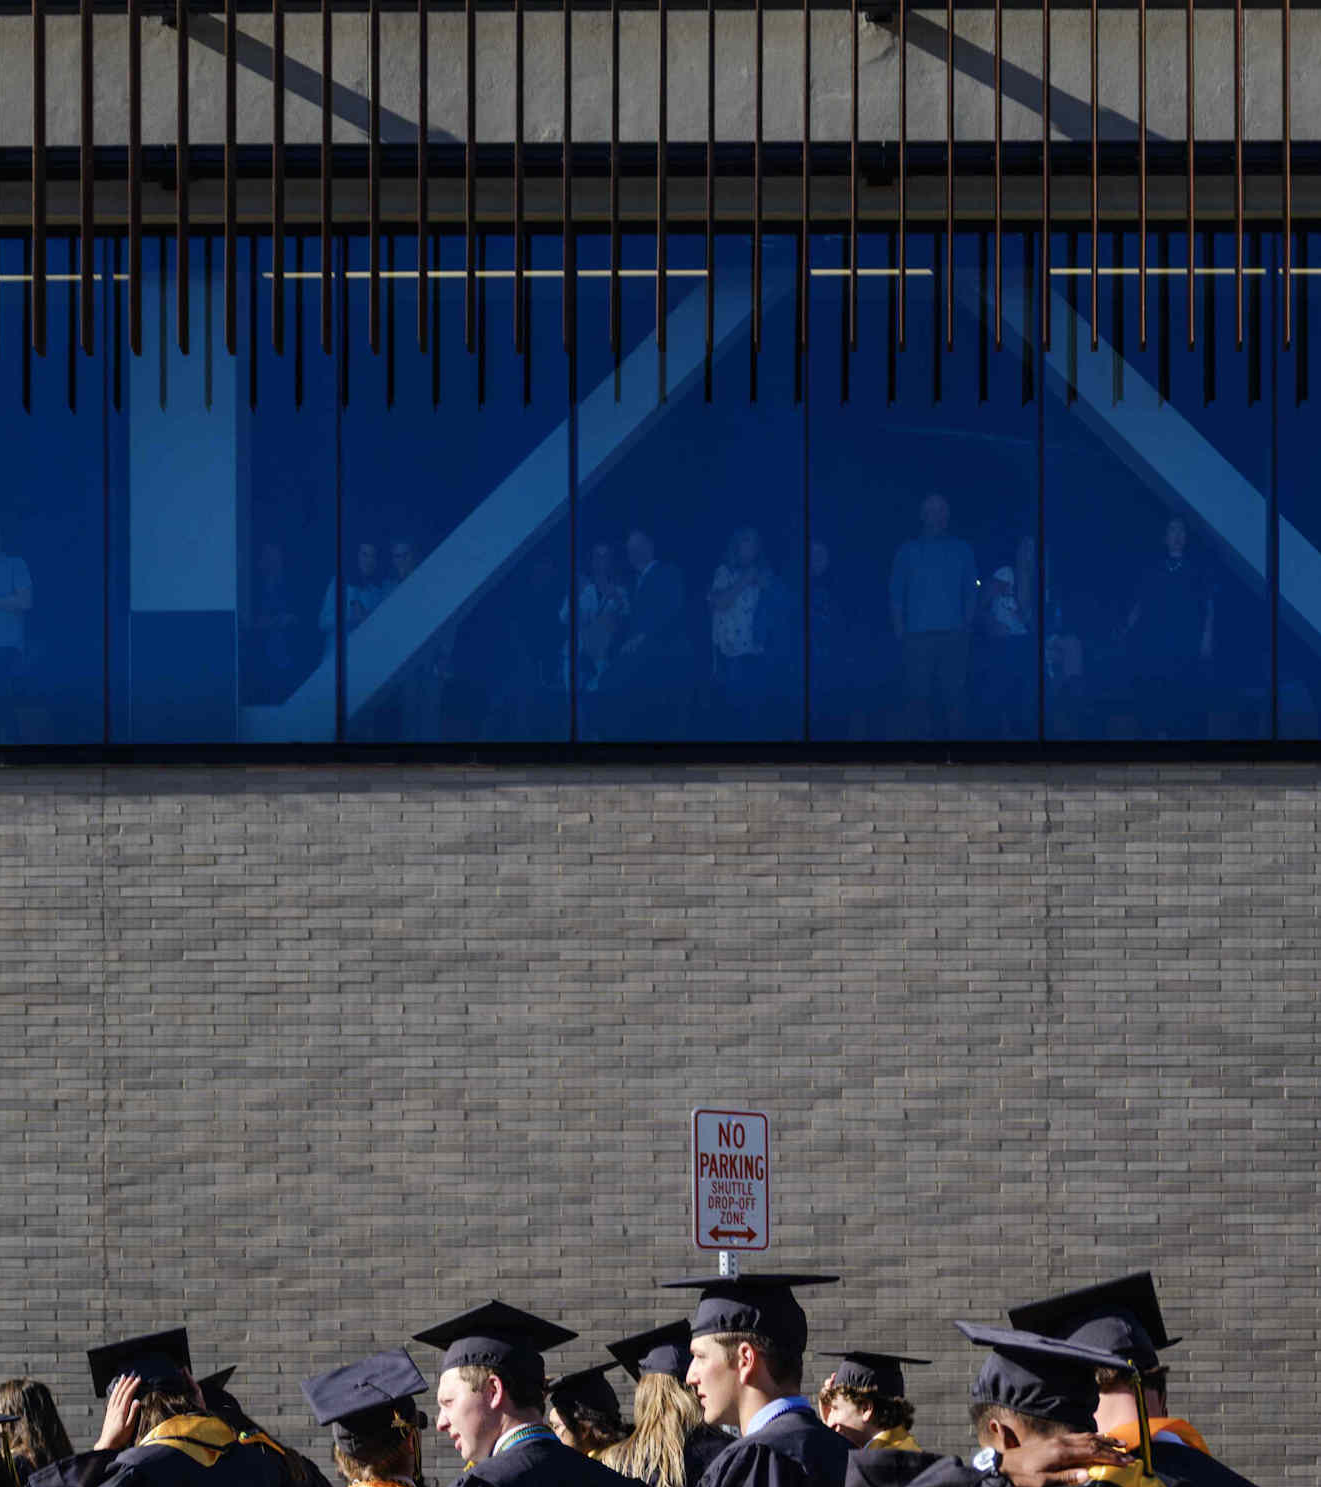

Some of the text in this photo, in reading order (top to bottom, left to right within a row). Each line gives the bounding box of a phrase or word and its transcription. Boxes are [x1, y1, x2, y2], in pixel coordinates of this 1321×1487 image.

[718, 1122, 745, 1148] NO
[700, 1152, 764, 1181] PARKING
[711, 1181, 753, 1196] SHUTTLE
[708, 1196, 756, 1210] DROP-OFF
[719, 1211, 746, 1225] ZONE
